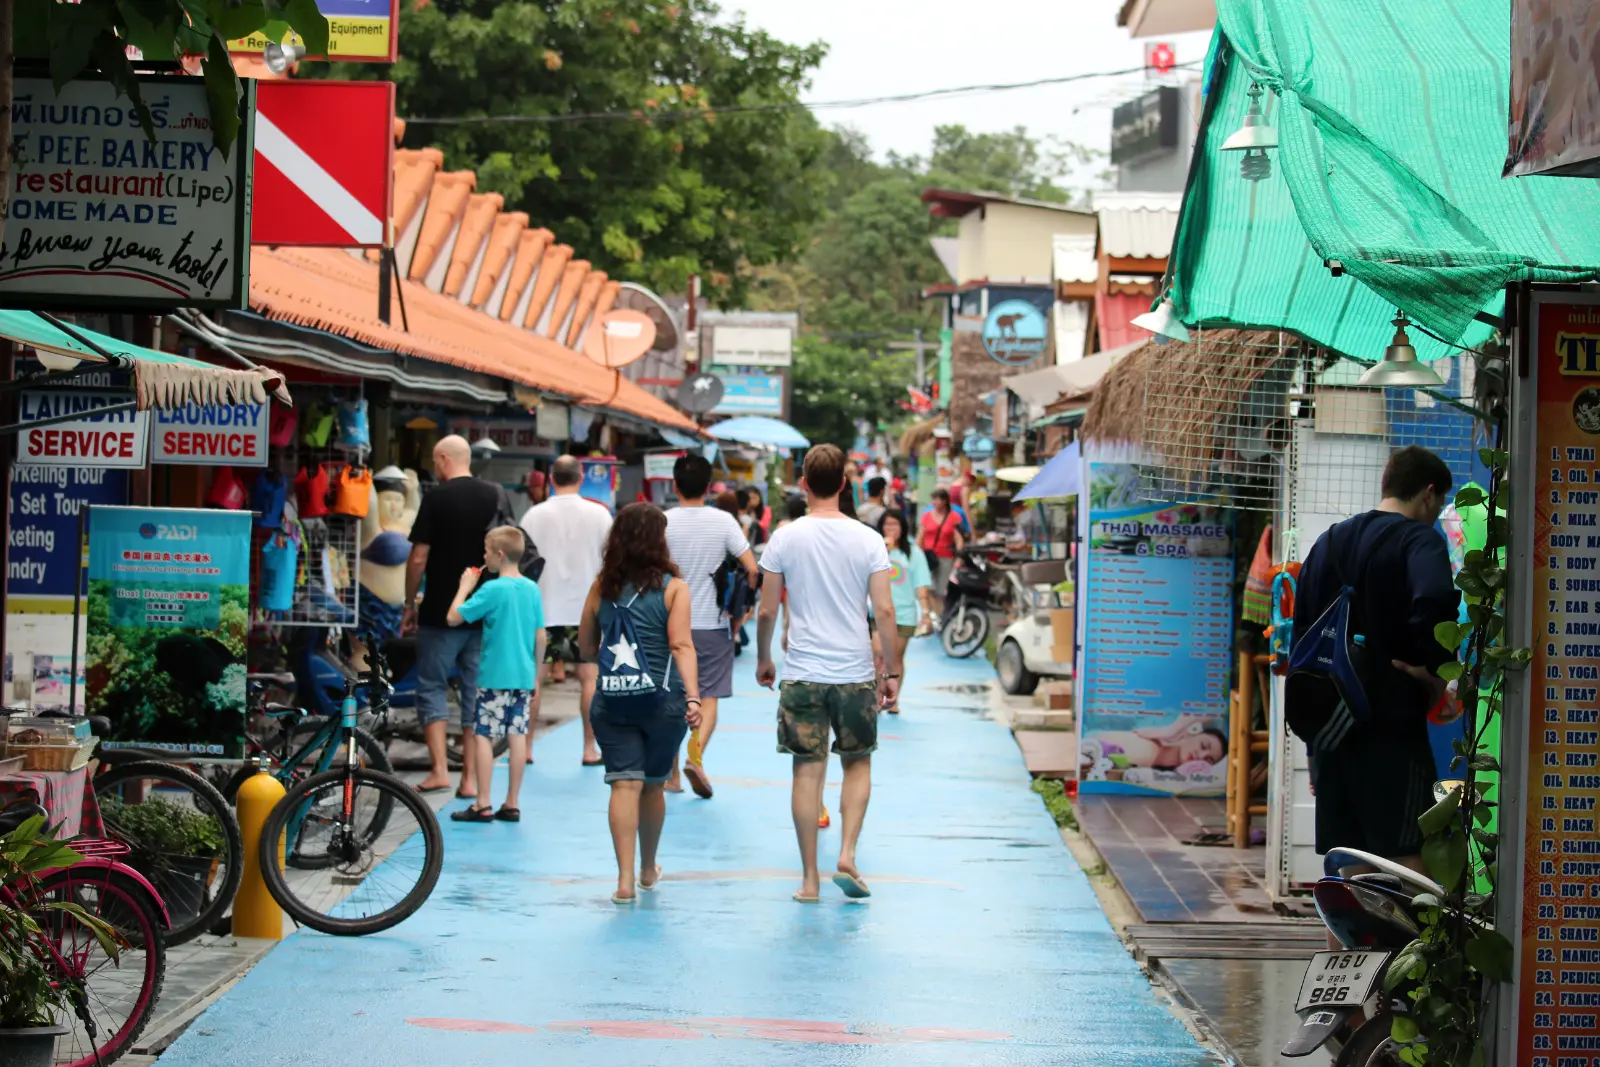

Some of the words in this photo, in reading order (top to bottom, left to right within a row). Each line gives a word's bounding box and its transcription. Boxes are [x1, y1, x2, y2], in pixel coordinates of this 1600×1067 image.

[331, 21, 383, 36] Equipment
[102, 138, 214, 172] BAKERY
[5, 199, 77, 220] OME
[85, 202, 177, 226] MADE
[158, 402, 262, 427] LAUNDRY
[28, 430, 134, 457] SERVICE
[163, 431, 256, 457] SERVICE
[1552, 447, 1560, 460] 1.
[1567, 448, 1595, 461] THAI
[1552, 469, 1562, 482] 2.
[1569, 470, 1588, 482] OIL
[20, 492, 47, 515] Set
[1551, 491, 1561, 504] 3.
[1568, 492, 1598, 504] FOOT
[1551, 513, 1561, 526] 4.
[1568, 514, 1597, 526] MILK
[157, 525, 197, 540] PADI
[1101, 522, 1137, 535] THAI
[1145, 524, 1223, 537] MASSAGE
[1550, 535, 1580, 548] BODY
[1137, 544, 1147, 555] &
[1155, 545, 1187, 556] SPA
[1549, 557, 1559, 569] 5.
[1567, 557, 1596, 570] BODY
[1549, 578, 1559, 591] 6.
[1549, 600, 1558, 613] 7.
[1566, 601, 1588, 613] EAR
[1548, 622, 1558, 634] 8.
[1548, 644, 1557, 656] 9.
[1547, 666, 1561, 678] 10.
[1568, 666, 1598, 679] YOGA
[602, 673, 655, 692] IBIZA
[1547, 688, 1558, 700] 11.
[1565, 688, 1596, 701] HEAT
[1545, 710, 1560, 722] 12.
[1567, 710, 1598, 722] HEAT
[1545, 731, 1559, 744] 13.
[1566, 732, 1597, 744] HEAT
[1544, 753, 1559, 765] 14.
[1566, 753, 1597, 766] HEAT
[1544, 775, 1562, 787] OIL
[1543, 797, 1557, 809] 15.
[1564, 797, 1595, 810] HEAT
[1542, 818, 1556, 831] 16.
[1563, 819, 1594, 831] BACK
[1541, 840, 1556, 852] 17.
[1541, 862, 1555, 874] 18.
[1540, 884, 1554, 896] 19.
[1561, 884, 1584, 897] HOT
[1539, 906, 1556, 918] 20.
[1538, 927, 1553, 940] 21.
[1560, 928, 1597, 940] SHAVE
[1537, 949, 1556, 962] 22.
[1536, 971, 1554, 983] 23.
[1309, 986, 1350, 1004] 986
[1536, 992, 1553, 1005] 24.
[1535, 1014, 1552, 1027] 25.
[1559, 1015, 1596, 1027] PLUCK
[1534, 1036, 1551, 1048] 26.
